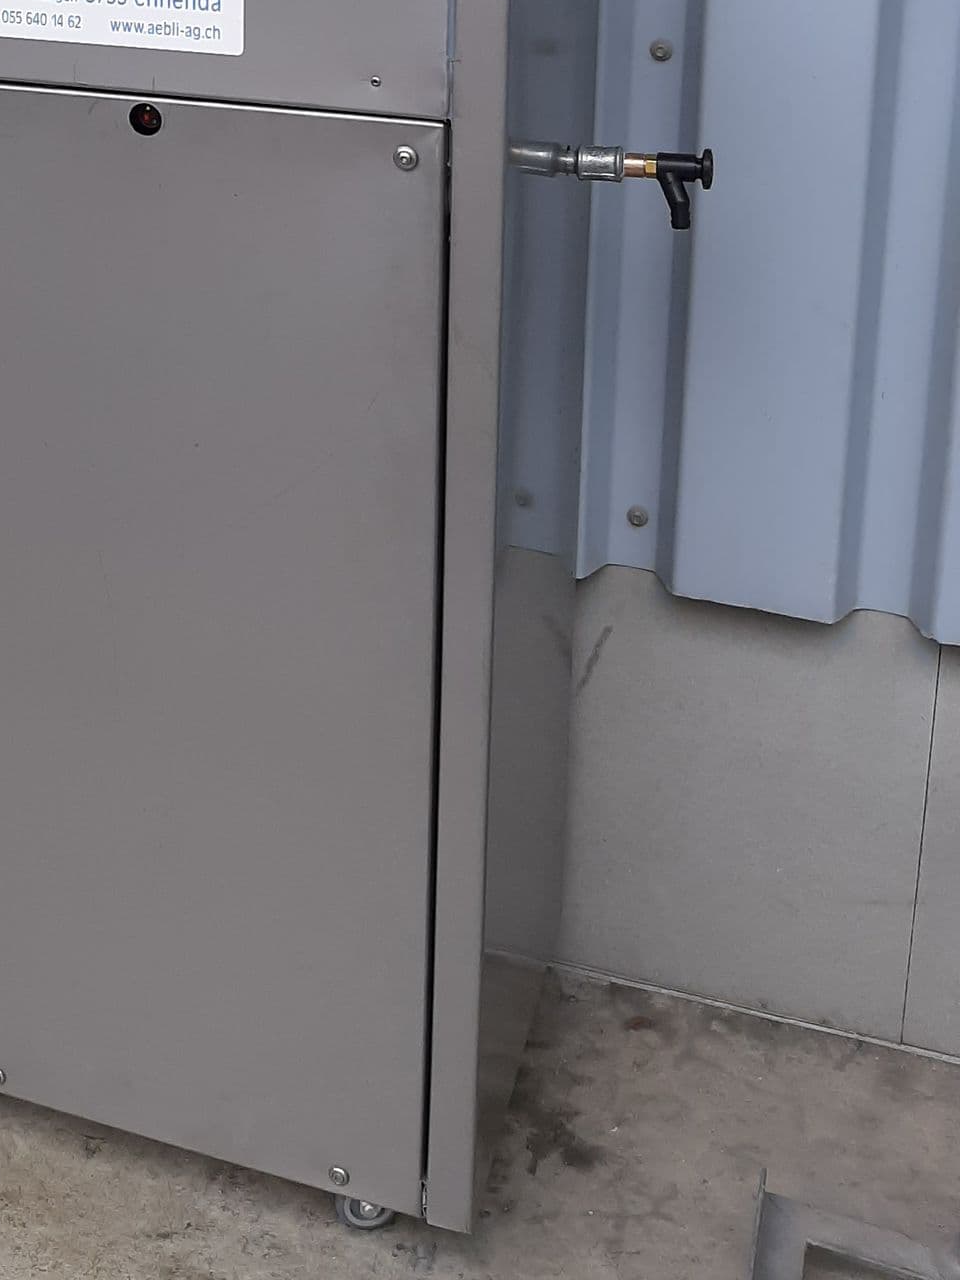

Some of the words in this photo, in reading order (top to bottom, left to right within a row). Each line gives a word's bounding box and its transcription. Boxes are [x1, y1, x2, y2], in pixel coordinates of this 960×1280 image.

[1, 10, 22, 24] 055
[25, 11, 48, 26] 640
[51, 14, 64, 27] 14
[67, 15, 82, 29] 62
[110, 19, 222, 40] www.aebli-ag.ch
